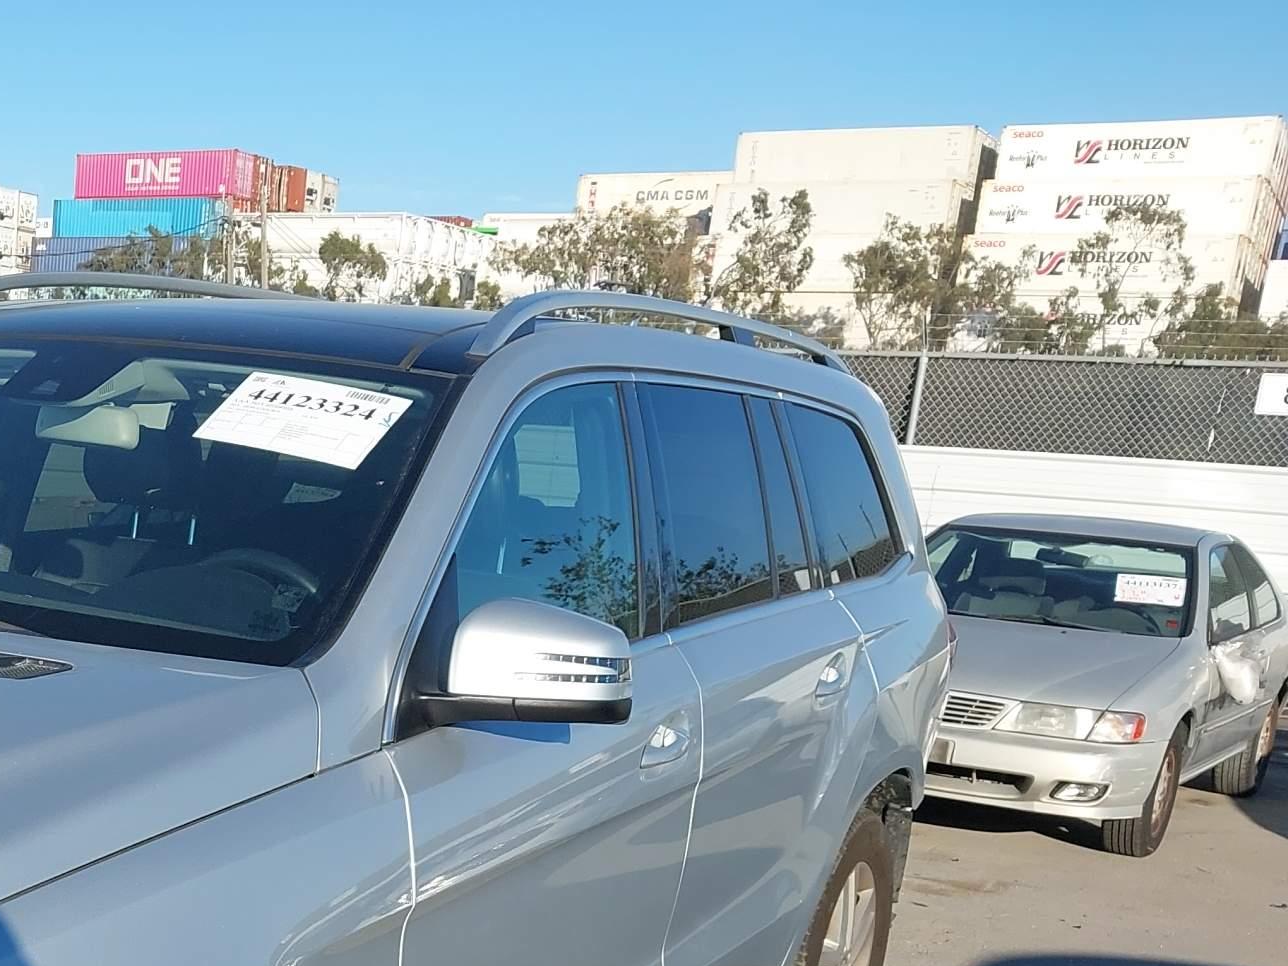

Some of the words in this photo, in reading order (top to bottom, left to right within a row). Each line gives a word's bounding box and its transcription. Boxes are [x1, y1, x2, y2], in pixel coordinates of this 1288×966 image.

[1012, 129, 1045, 139] seaco
[1106, 136, 1190, 151] HORIZON
[1103, 151, 1176, 161] LINES
[125, 157, 182, 184] ONE
[992, 184, 1025, 193] seaco
[636, 190, 670, 201] CMA
[674, 189, 709, 201] CGM
[1087, 194, 1170, 207] HORIZON
[973, 239, 1006, 248] seaco
[248, 387, 377, 421] 44123324
